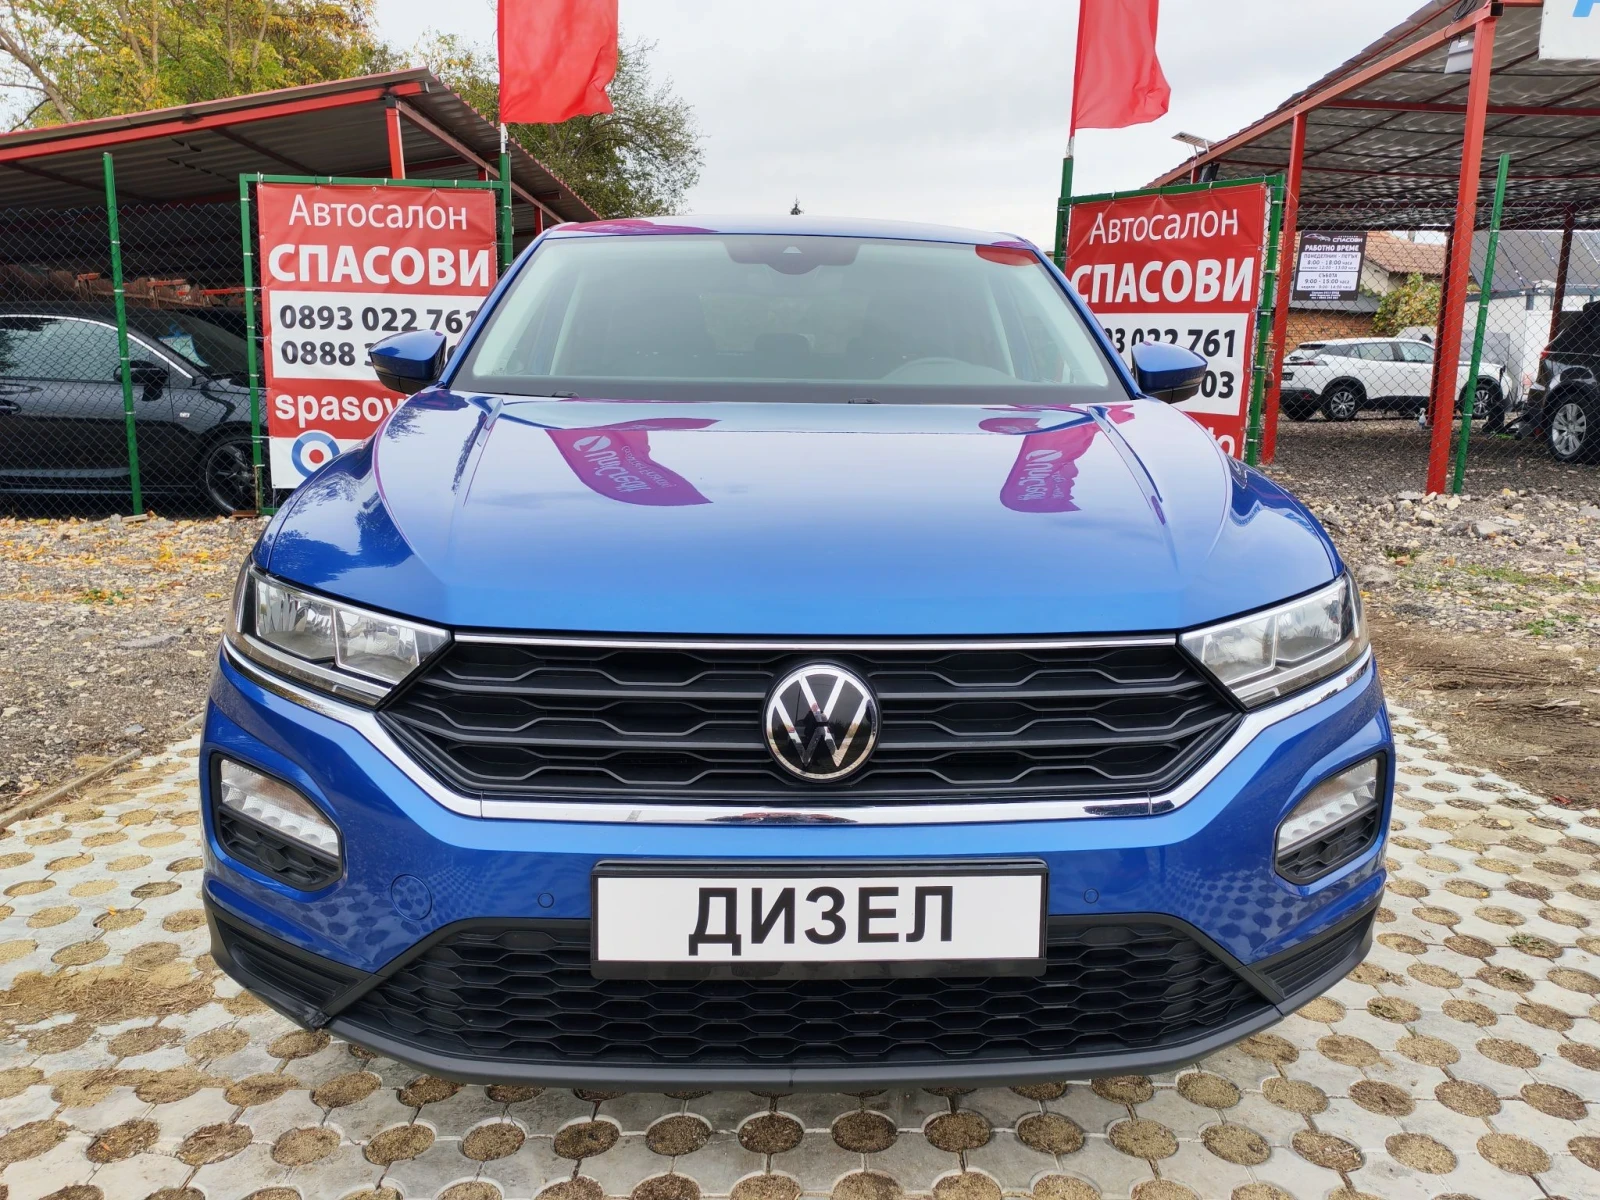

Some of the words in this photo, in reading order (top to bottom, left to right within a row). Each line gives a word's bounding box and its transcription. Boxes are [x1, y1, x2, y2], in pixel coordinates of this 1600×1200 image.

[288, 193, 468, 231] Автосалон
[1088, 208, 1239, 246] Автосалон
[268, 243, 490, 288] СПАСОВИ
[1070, 257, 1255, 304] СПАСОВИ
[279, 304, 353, 331] 0893
[361, 306, 418, 332] 022
[281, 340, 356, 367] 0888
[1187, 328, 1236, 358] 761
[688, 885, 954, 957] ДИЗЕЛ
